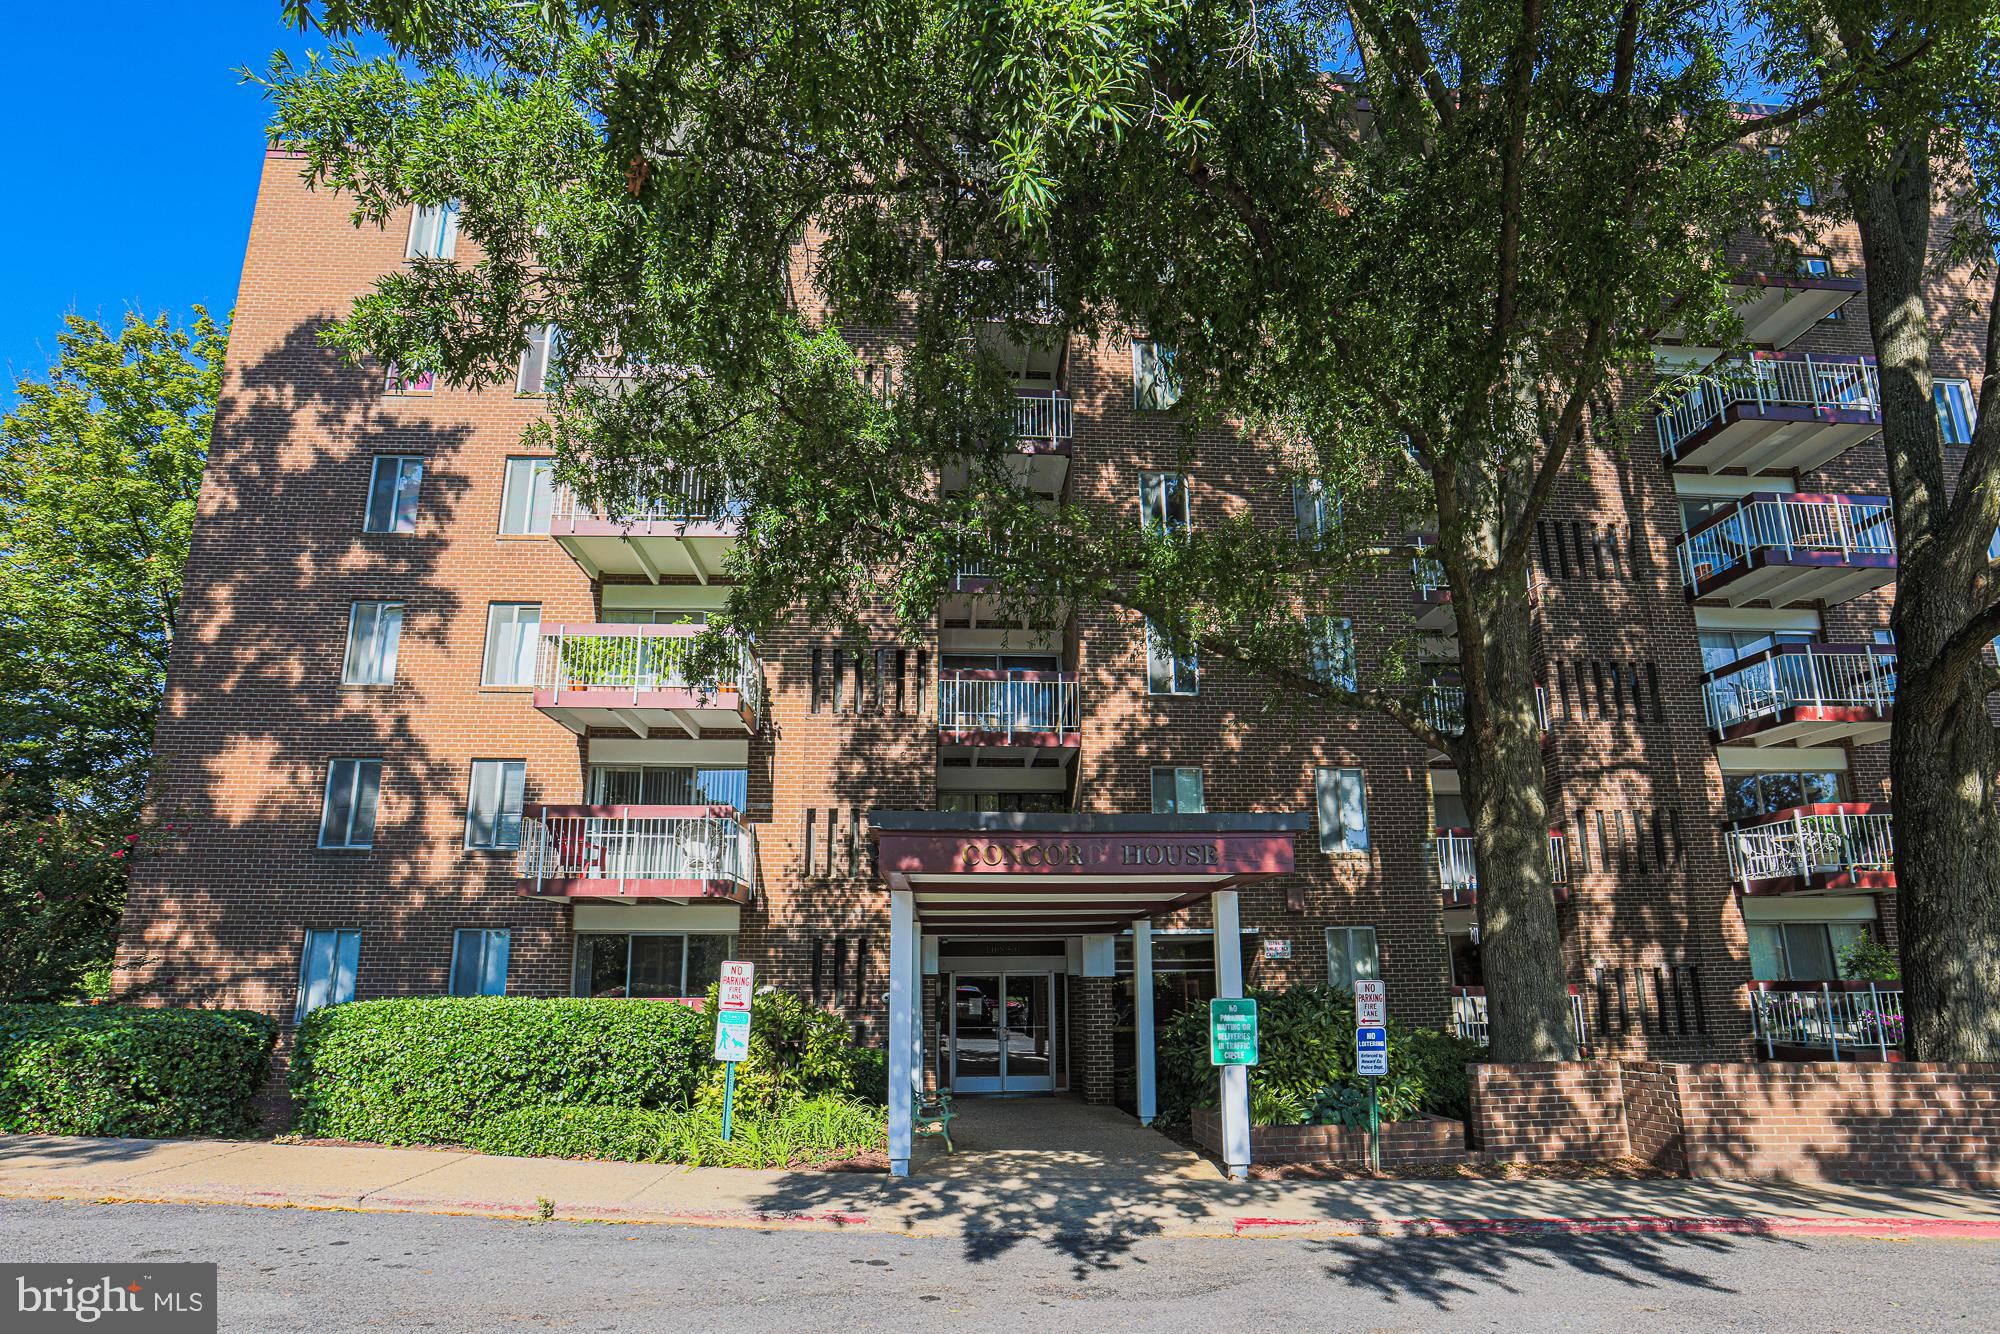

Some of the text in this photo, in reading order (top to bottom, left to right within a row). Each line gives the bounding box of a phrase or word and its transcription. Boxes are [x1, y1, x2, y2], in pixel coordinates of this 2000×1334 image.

[1122, 844, 1218, 866] HOUSE
[731, 966, 742, 976] NO
[723, 976, 750, 986] PARKING
[1364, 984, 1376, 992] NO
[1358, 994, 1383, 1002] PARKING
[1217, 1023, 1251, 1031] WAITING OR
[1217, 1032, 1251, 1040] DELIVERIES
[1366, 1032, 1376, 1040] NO
[1226, 1042, 1250, 1050] TRAFFIC
